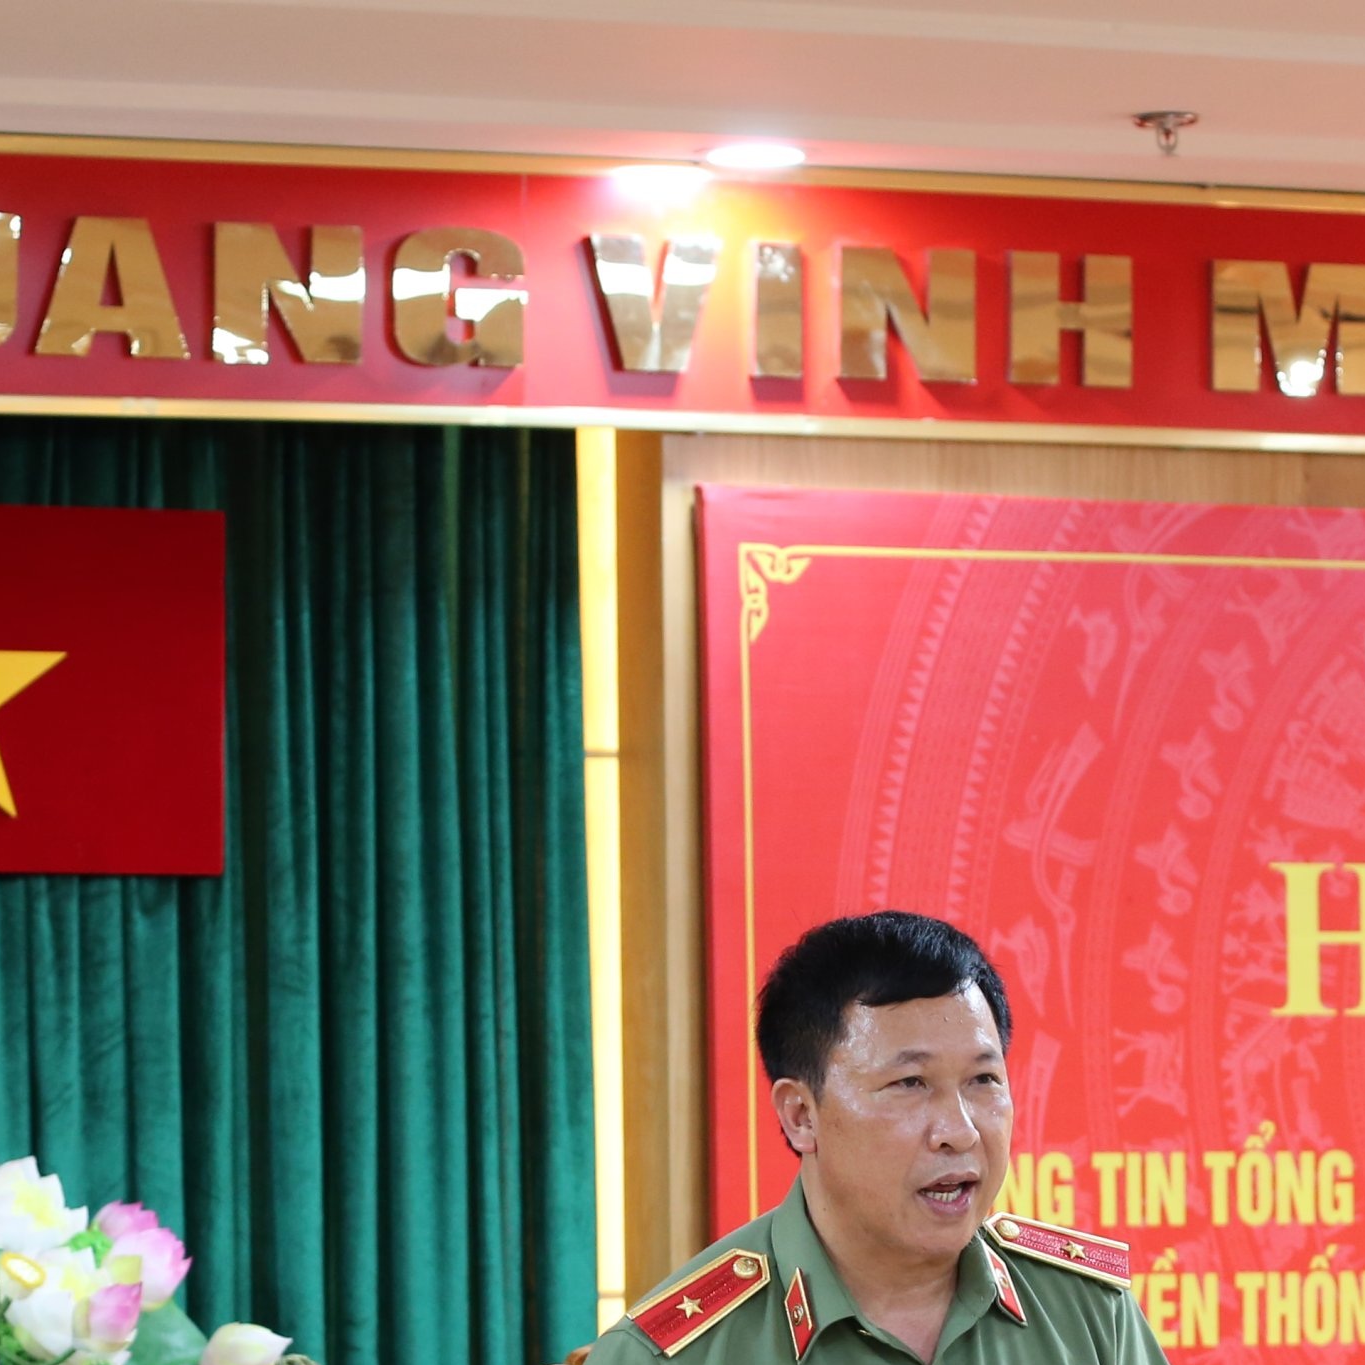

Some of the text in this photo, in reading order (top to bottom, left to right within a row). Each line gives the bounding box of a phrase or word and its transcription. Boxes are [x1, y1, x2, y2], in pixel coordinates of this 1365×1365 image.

[588, 232, 1133, 388] VINH
[1092, 1151, 1187, 1227] TIN
[1204, 1121, 1354, 1227] TỔNG
